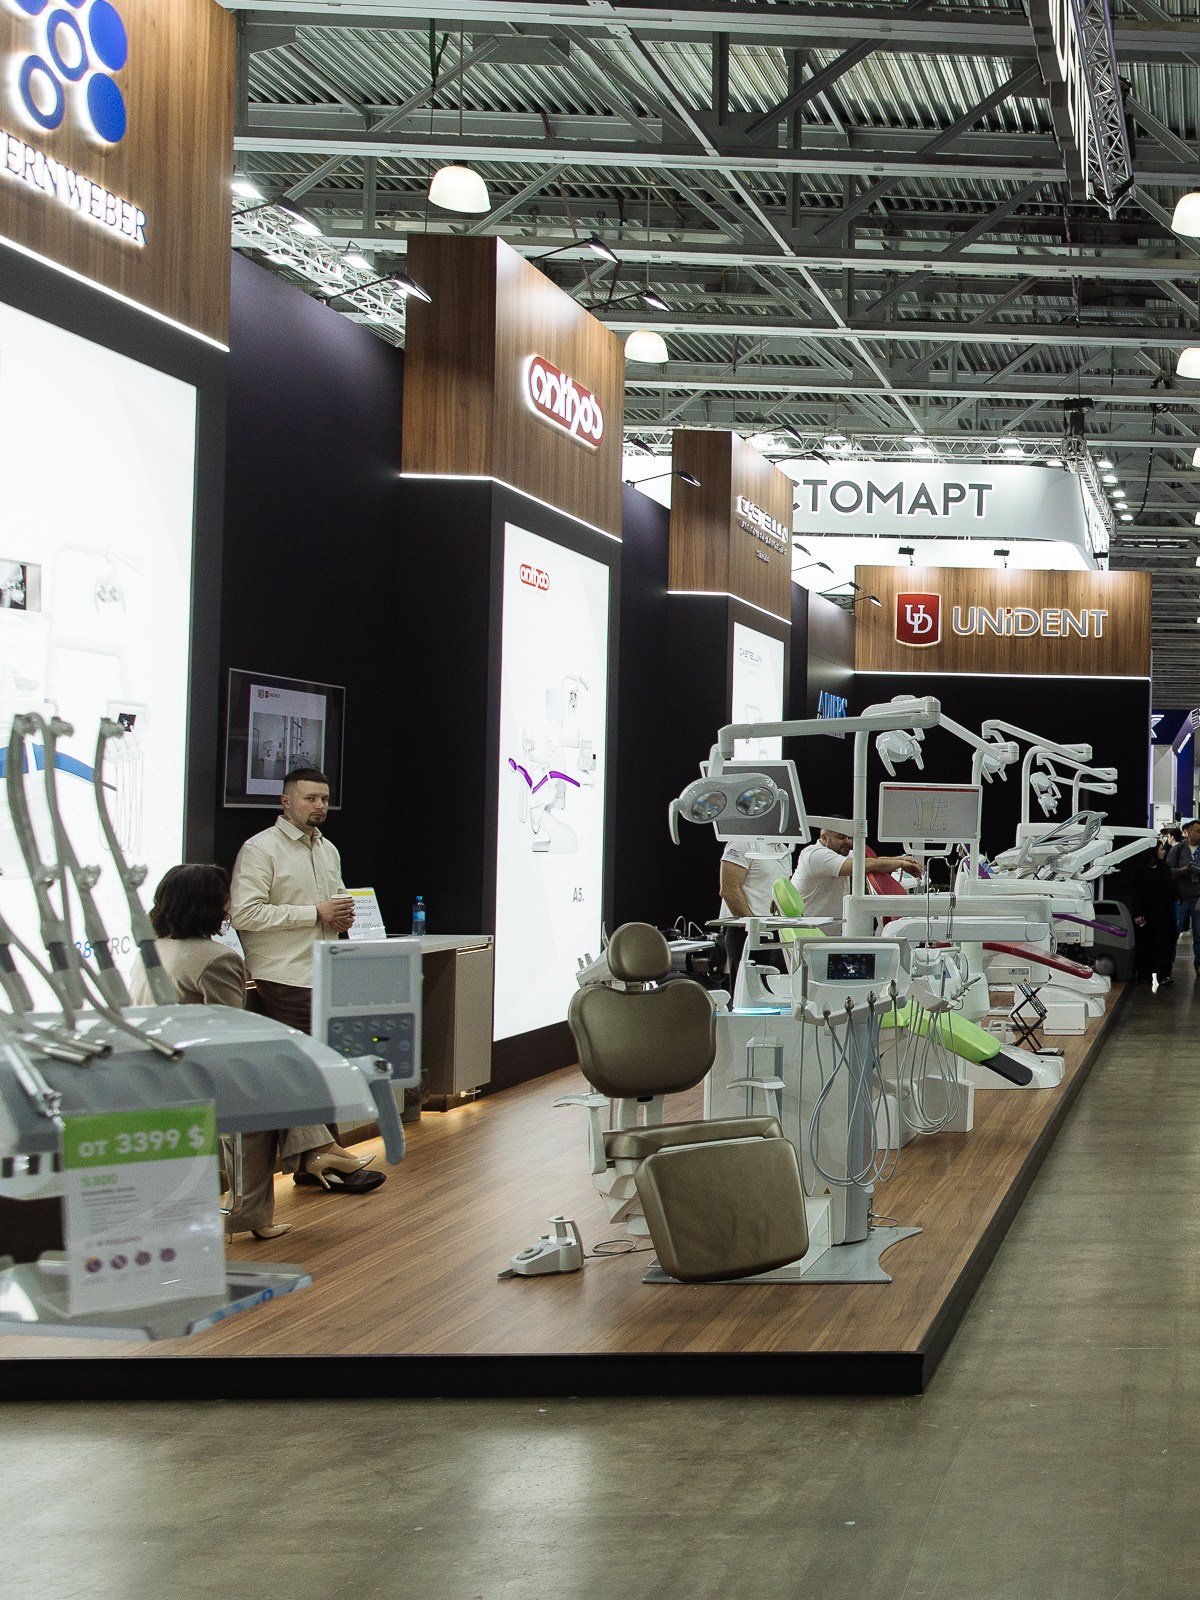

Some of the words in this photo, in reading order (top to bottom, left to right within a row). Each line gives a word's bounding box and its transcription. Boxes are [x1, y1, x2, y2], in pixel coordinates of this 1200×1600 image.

[793, 479, 993, 517] ТОМАРТ
[78, 1140, 109, 1157] от
[115, 1129, 181, 1154] 3399
[187, 1124, 205, 1149] $
